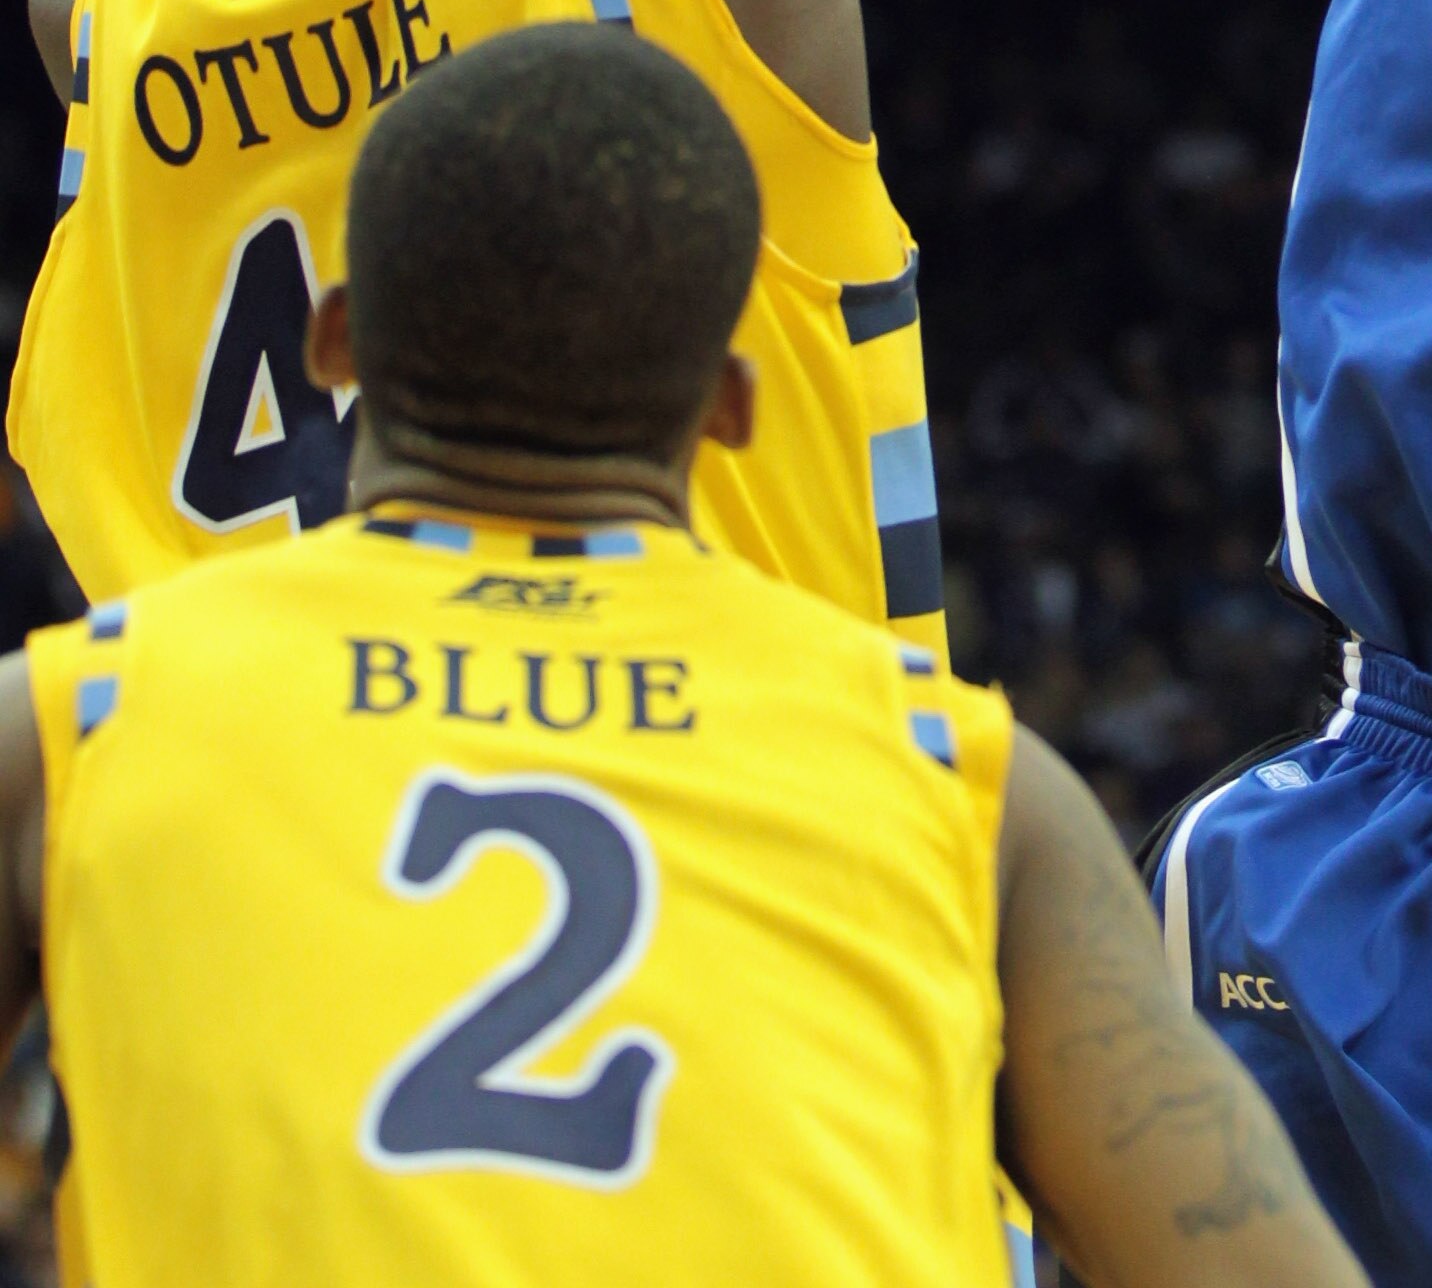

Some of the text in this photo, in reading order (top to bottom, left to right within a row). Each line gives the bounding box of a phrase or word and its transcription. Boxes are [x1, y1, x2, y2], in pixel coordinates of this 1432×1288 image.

[349, 639, 696, 732] BLUE
[357, 766, 678, 1194] 2
[1219, 972, 1291, 1011] ACC
